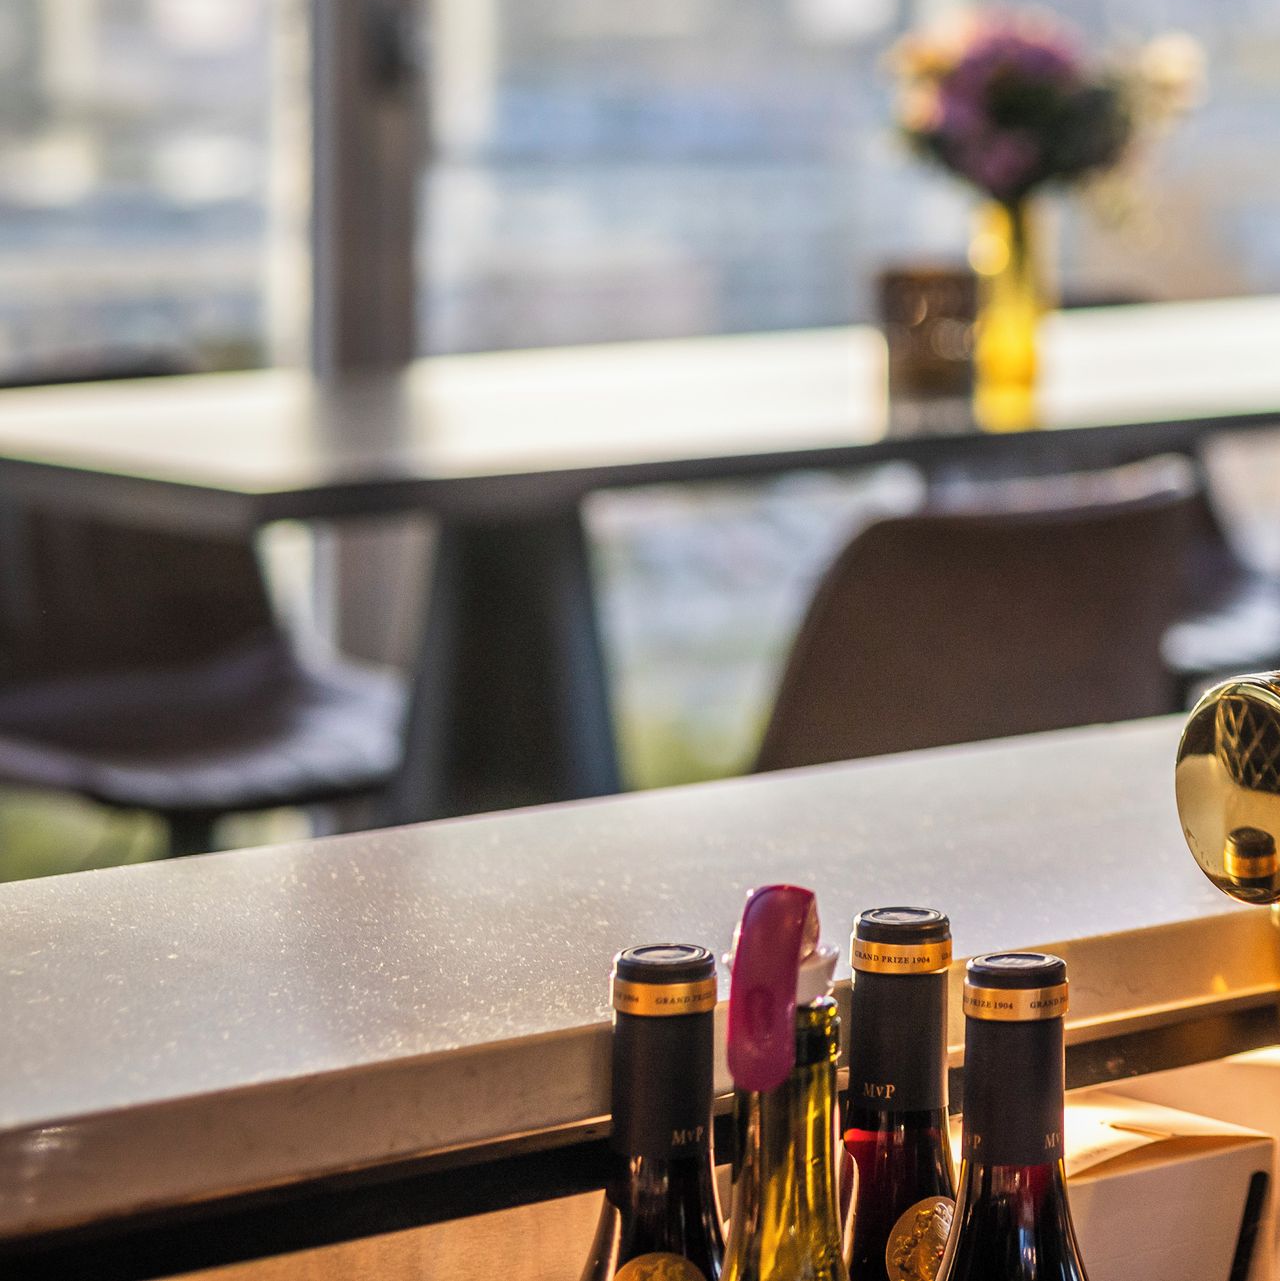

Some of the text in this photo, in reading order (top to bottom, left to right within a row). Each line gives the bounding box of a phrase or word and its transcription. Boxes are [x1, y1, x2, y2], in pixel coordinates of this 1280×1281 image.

[854, 950, 931, 964] GRAND PRIZE 1904
[993, 1001, 1014, 1010] 1904
[863, 1081, 896, 1099] MvP
